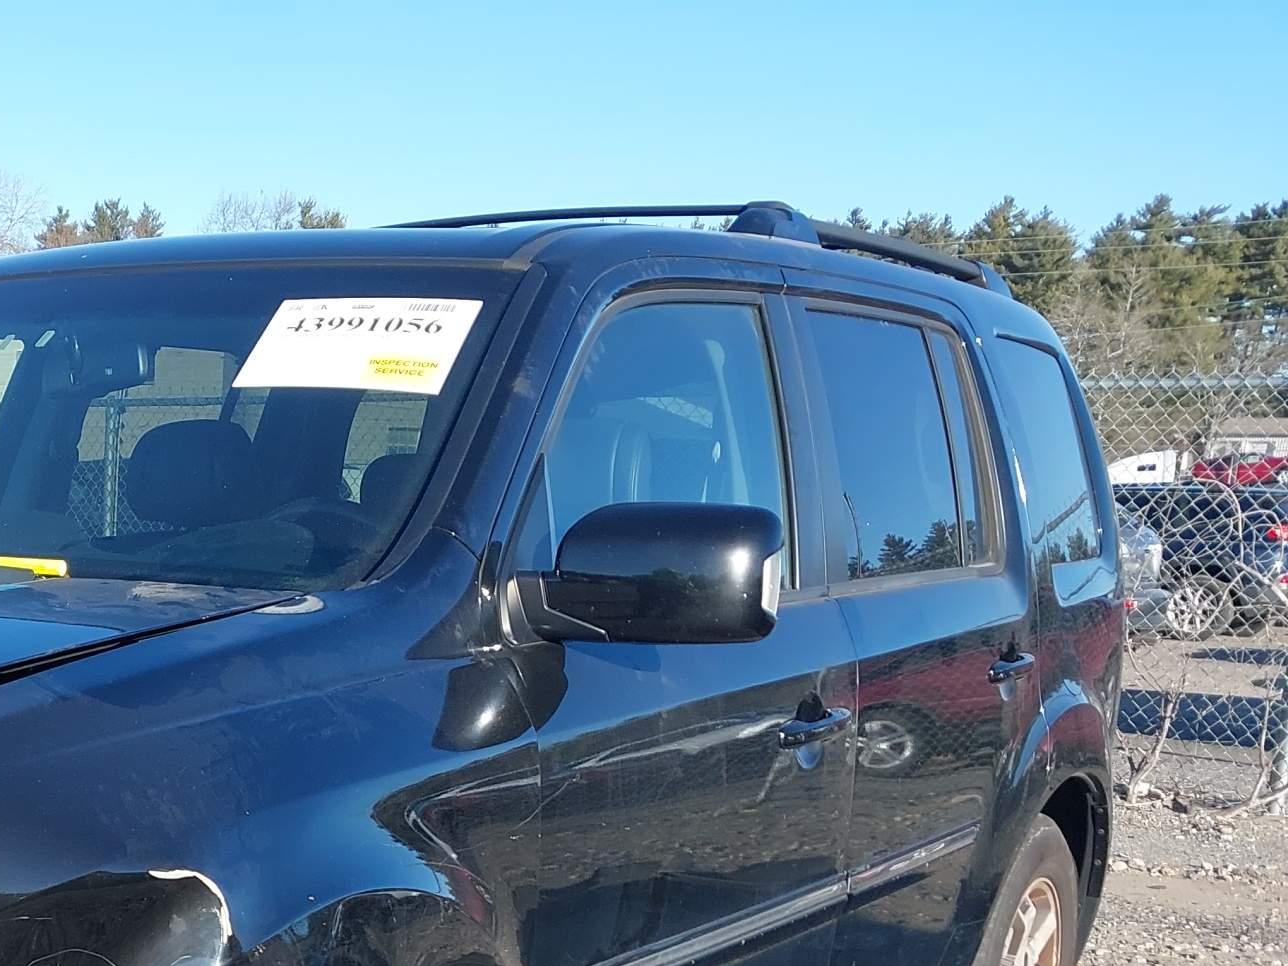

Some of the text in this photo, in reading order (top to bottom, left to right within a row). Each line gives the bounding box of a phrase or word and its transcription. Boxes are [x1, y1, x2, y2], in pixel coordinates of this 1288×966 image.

[287, 316, 443, 334] 43991056
[369, 359, 439, 369] INSPECTION
[374, 367, 425, 377] SERVICE
